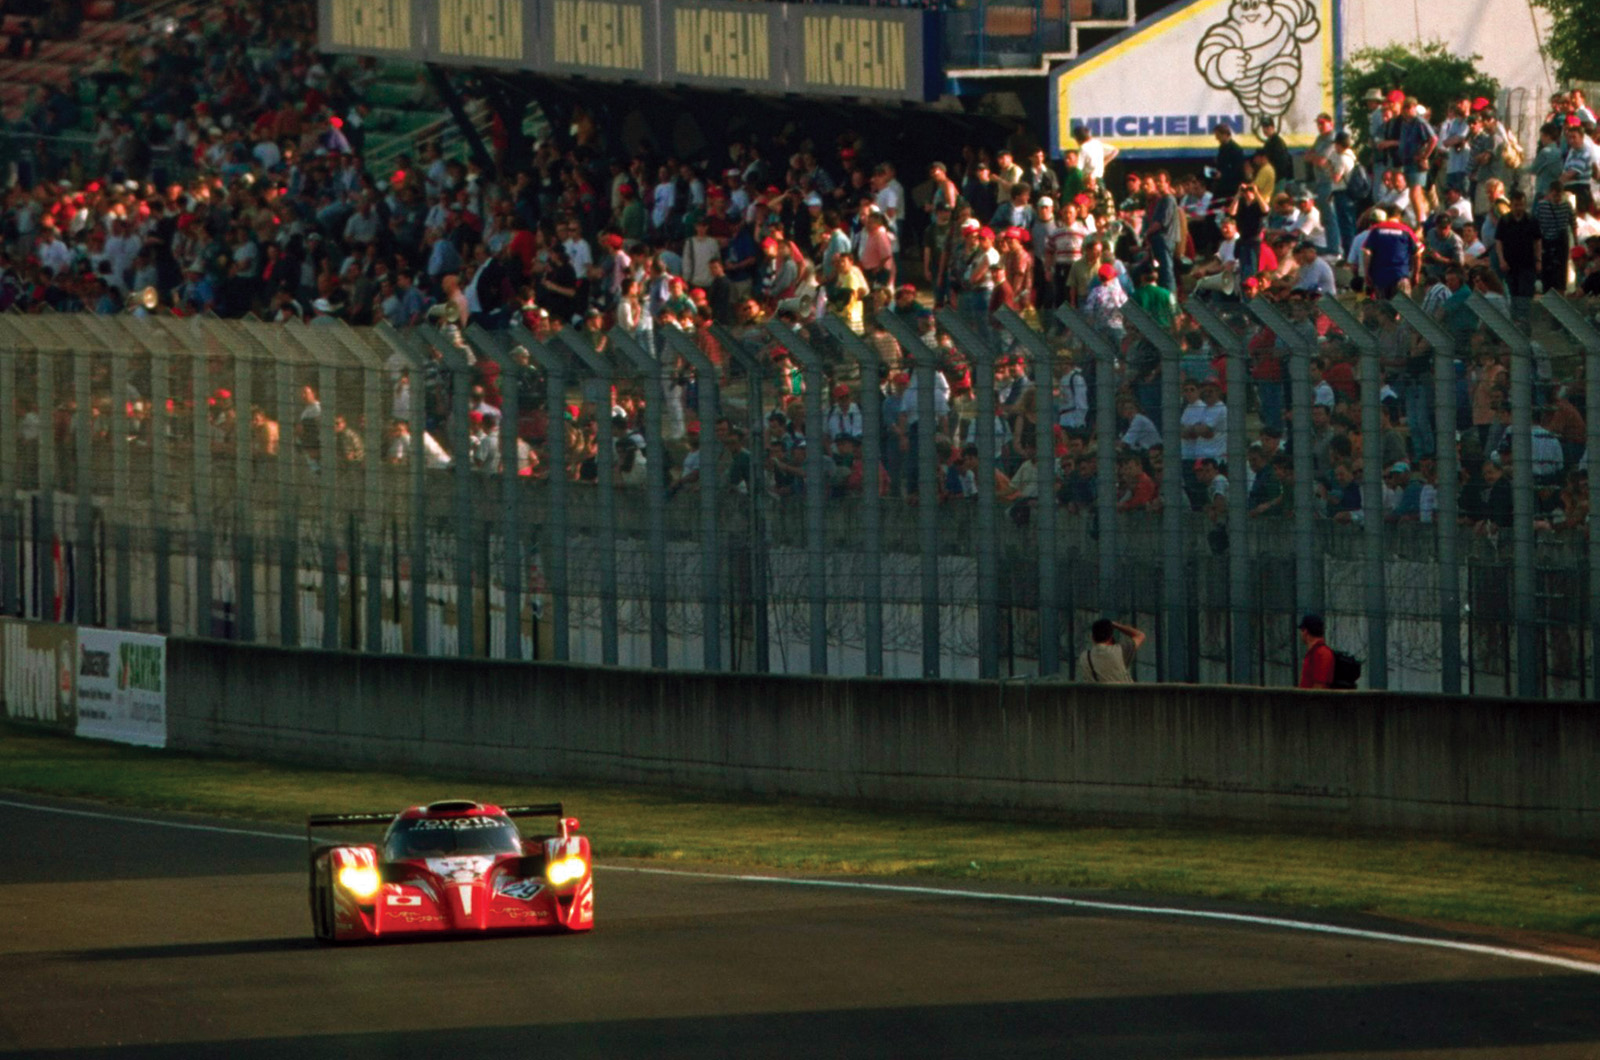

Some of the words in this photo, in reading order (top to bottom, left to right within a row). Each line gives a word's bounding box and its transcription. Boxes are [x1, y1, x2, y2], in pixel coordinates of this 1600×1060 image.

[440, 0, 523, 59] MICHELIN
[554, 0, 643, 71] MICHELIN
[675, 8, 769, 80] MICHELIN
[804, 15, 906, 90] MICHELIN
[1069, 114, 1245, 138] MICHELIN
[415, 816, 497, 829] TOYOTA
[502, 884, 541, 899] 29
